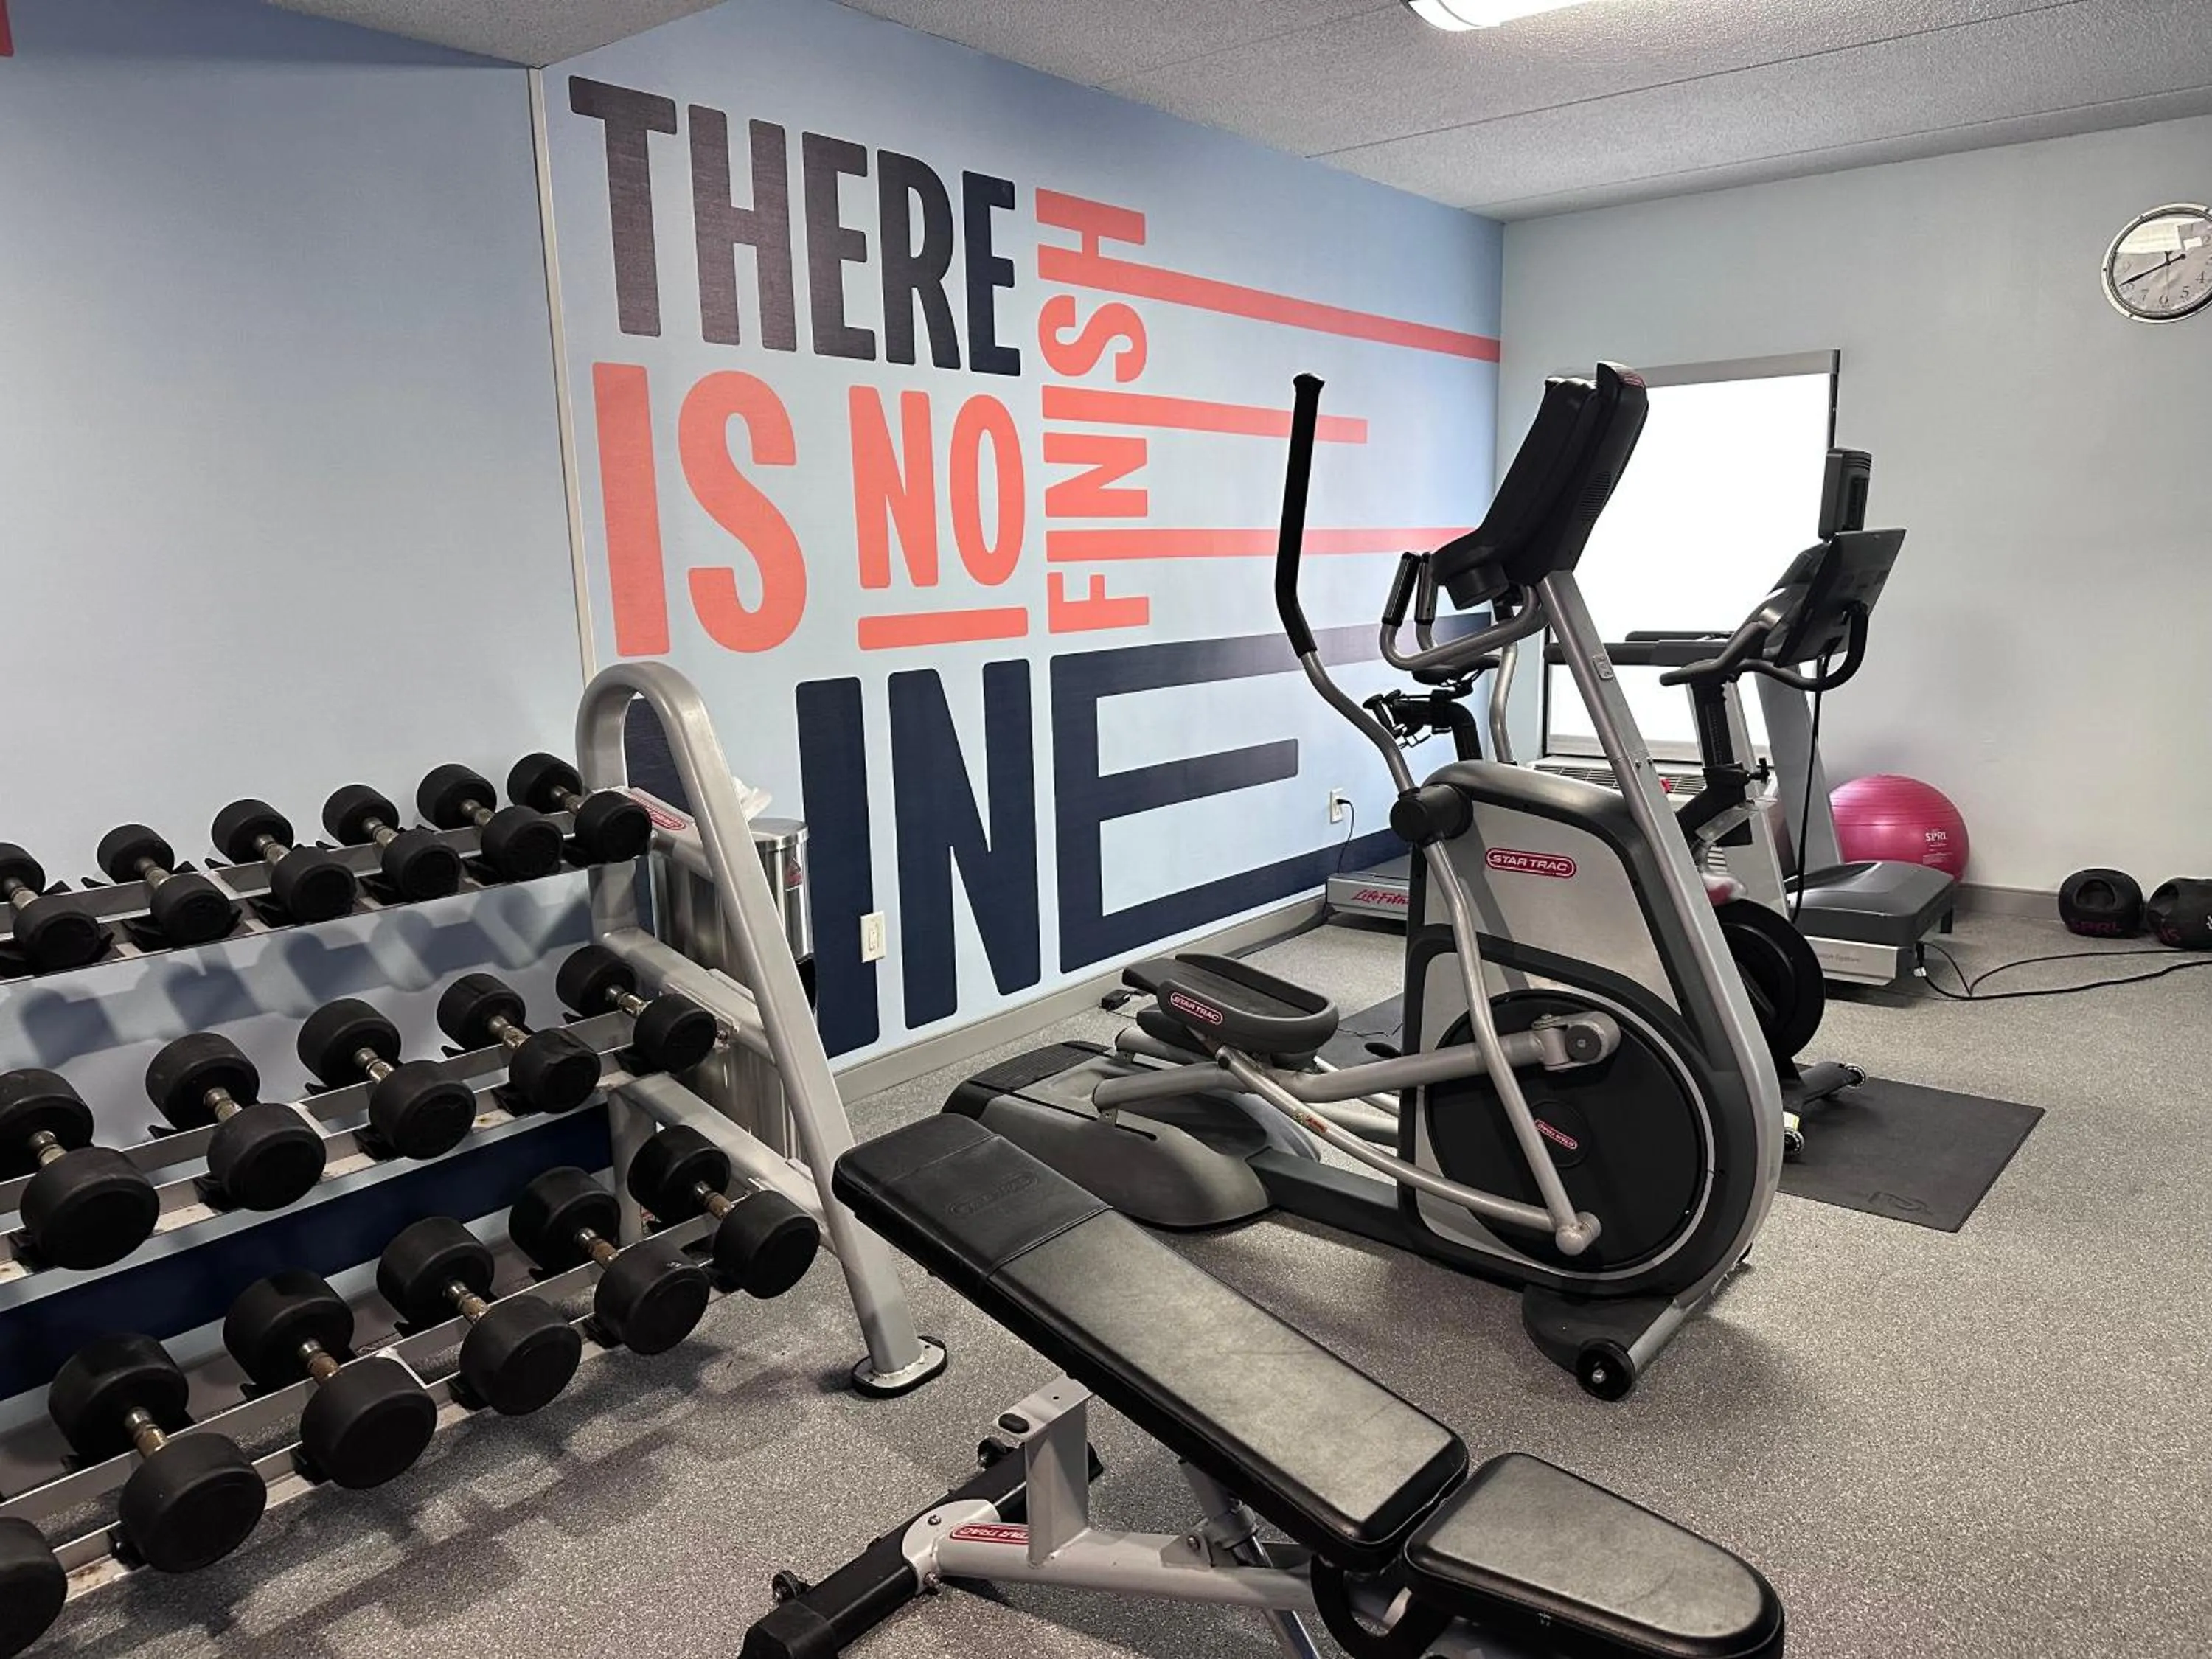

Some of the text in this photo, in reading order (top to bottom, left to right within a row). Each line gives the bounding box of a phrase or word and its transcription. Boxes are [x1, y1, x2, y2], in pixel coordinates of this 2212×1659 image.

[569, 76, 1021, 377] THERE
[592, 361, 1026, 657] IS NO
[1035, 187, 1148, 633] FINISH
[623, 625, 1357, 1060] INE
[1490, 855, 1568, 872] STAR TRAC
[1173, 996, 1220, 1021] STAR TRAC
